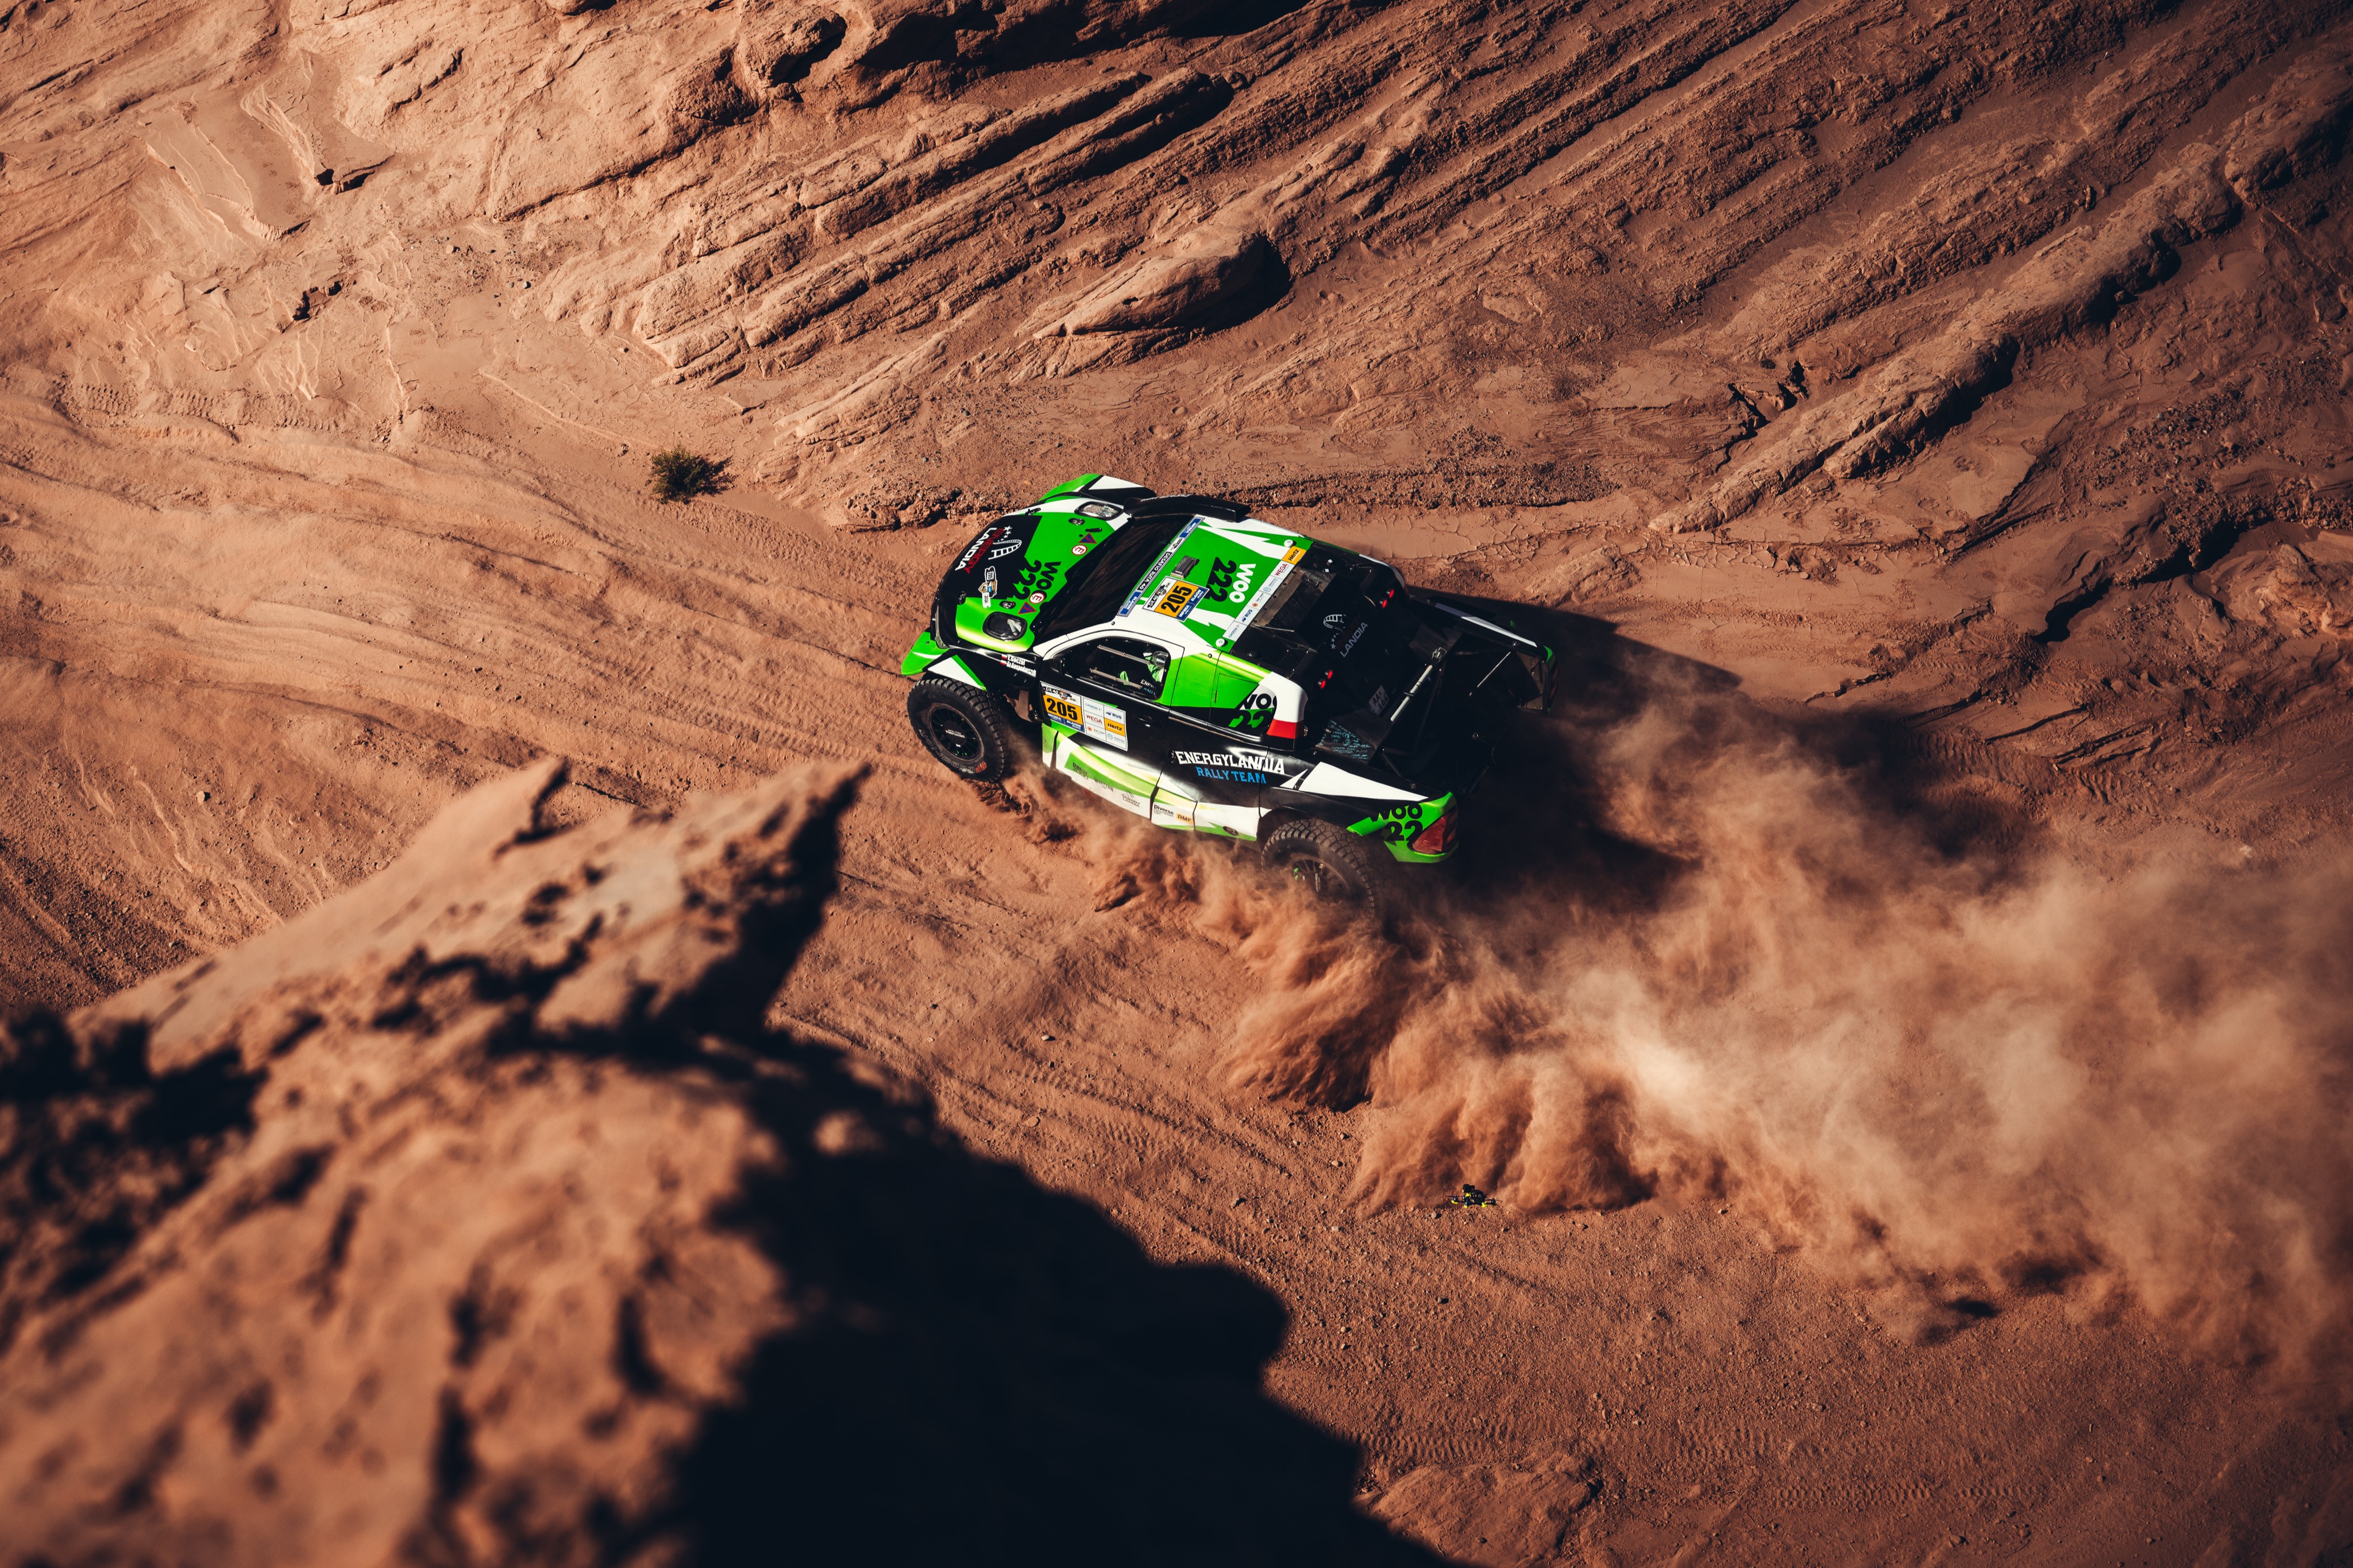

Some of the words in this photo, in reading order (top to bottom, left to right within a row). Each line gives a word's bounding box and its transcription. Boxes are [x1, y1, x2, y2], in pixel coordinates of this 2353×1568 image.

[955, 527, 997, 571] LANDIA
[964, 528, 1005, 574] ENERGY
[1287, 549, 1300, 561] Hertz
[1144, 571, 1156, 582] RUTA
[1203, 557, 1237, 602] 222
[1274, 563, 1288, 576] WEGA
[1032, 561, 1062, 600] WO
[1229, 563, 1256, 603] WOO
[1160, 586, 1192, 613] 205
[1244, 609, 1253, 618] RUS
[1340, 622, 1368, 657] LANDIA
[1046, 697, 1078, 721] 205
[1086, 714, 1102, 724] WEGA
[1108, 723, 1123, 732] Hertz
[1175, 751, 1285, 774] ENERGYLANDIA
[1195, 766, 1229, 781] RALLY
[1231, 770, 1267, 784] TEAM
[1154, 804, 1174, 815] Diverse
[1178, 814, 1192, 822] RMF
